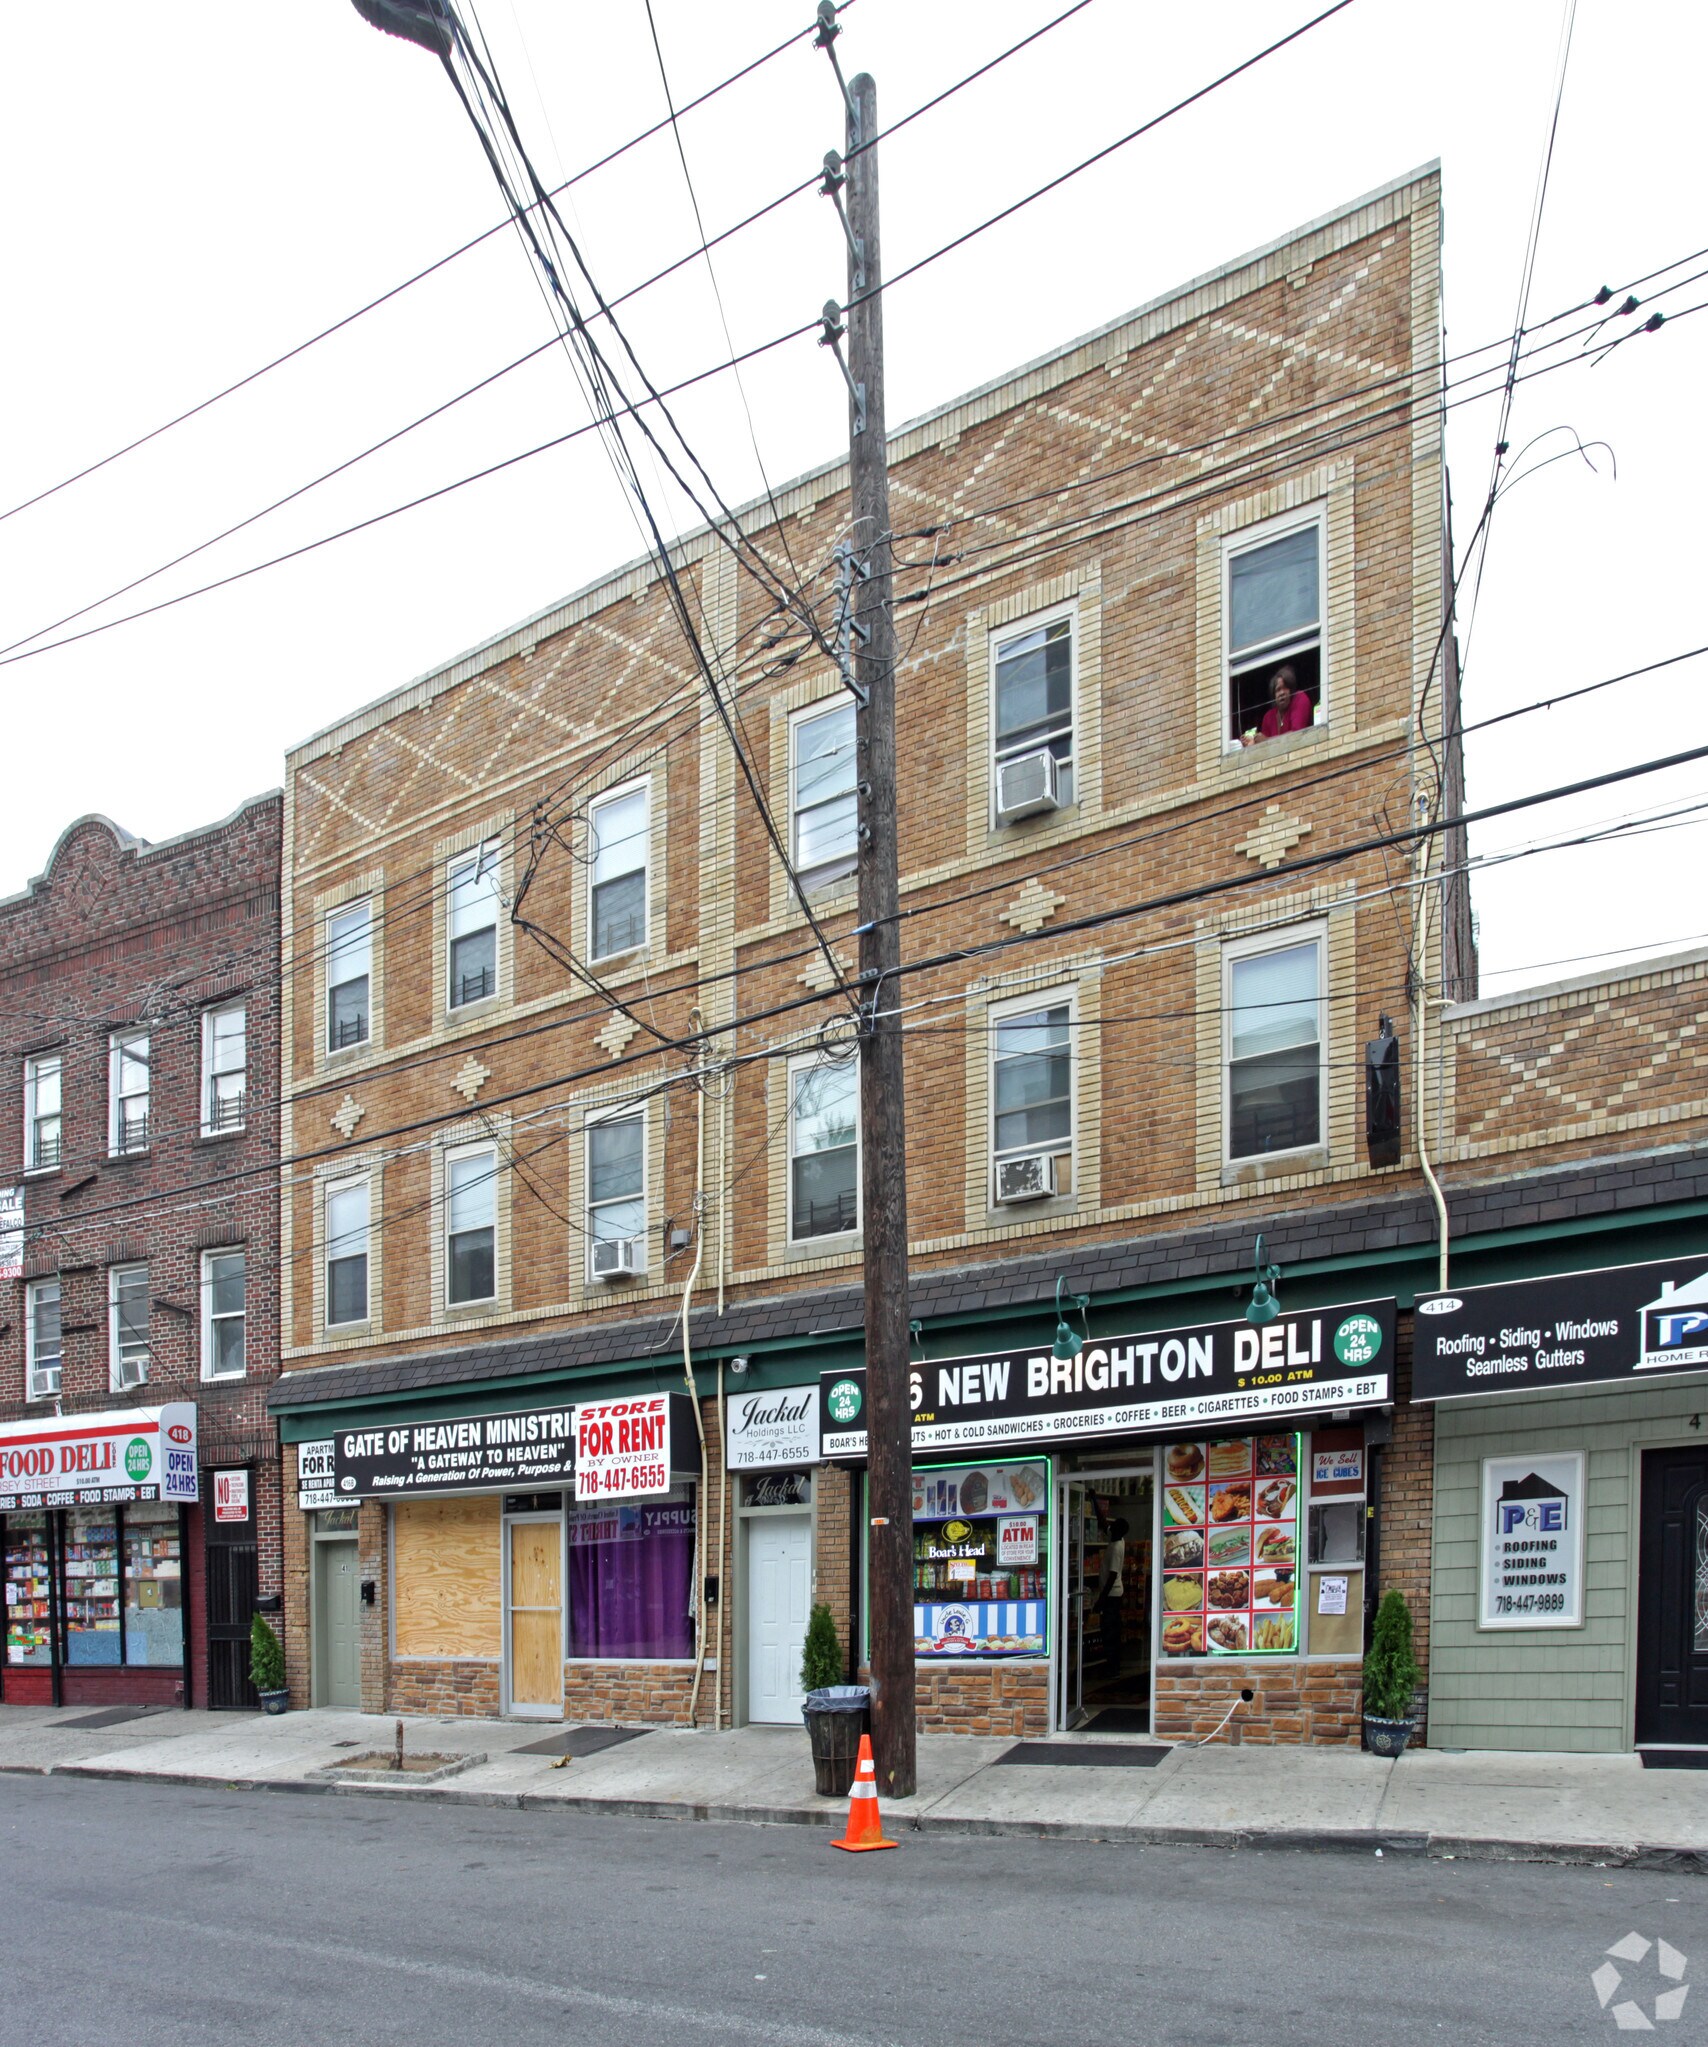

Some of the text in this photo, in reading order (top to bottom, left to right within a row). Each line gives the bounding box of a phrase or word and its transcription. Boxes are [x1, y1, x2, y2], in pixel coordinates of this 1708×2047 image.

[1426, 1300, 1456, 1312] 414
[1338, 1319, 1378, 1337] OPEN
[1350, 1334, 1366, 1348] 24
[1436, 1319, 1618, 1356] Roofing Siding Windows
[1343, 1346, 1372, 1362] HRS
[1646, 1352, 1694, 1364] HOME
[938, 1361, 1010, 1407] NEW
[1027, 1334, 1214, 1398] BRIGHTON
[1234, 1319, 1322, 1373] DELI
[1466, 1350, 1585, 1377] Seamless Gutters
[1238, 1369, 1314, 1388] $ 10.00 ATM
[831, 1384, 858, 1398] OPEN
[580, 1399, 665, 1421] STORE
[839, 1396, 851, 1408] 24
[732, 1393, 812, 1434] Jackal
[830, 1437, 857, 1448] BOAR'S
[934, 1429, 952, 1440] HOT
[954, 1428, 960, 1438] &
[962, 1425, 985, 1438] COLD
[986, 1420, 1044, 1436] SANDWICHES
[1053, 1414, 1105, 1430] GROCERIES
[1115, 1408, 1150, 1423] COFFEE
[1162, 1404, 1186, 1418] BEER
[1198, 1396, 1260, 1414] CIGARETTES
[1271, 1390, 1298, 1405] FOOD
[1302, 1386, 1344, 1402] STAMPS
[1356, 1382, 1377, 1395] EBT
[834, 1406, 856, 1419] HRS
[914, 1413, 935, 1422] ATM
[172, 1428, 188, 1440] 418
[580, 1414, 666, 1458] FOR RENT
[746, 1424, 806, 1438] Holdings LLC
[344, 1432, 384, 1458] GATE
[388, 1430, 409, 1454] OF
[413, 1423, 480, 1452] HEAVEN
[60, 1442, 112, 1474] DELI
[128, 1445, 148, 1458] OPEN
[428, 1450, 482, 1469] GATEWAY
[487, 1450, 502, 1463] TO
[737, 1446, 810, 1464] 718-447-6555
[1319, 1453, 1358, 1466] We Sell
[128, 1458, 150, 1472] 24 HRS
[168, 1452, 192, 1472] OPEN
[302, 1456, 324, 1475] FOR
[588, 1453, 659, 1468] BY OWNER
[372, 1460, 572, 1487] Raising A Generation Of Power, Purpose &
[579, 1464, 665, 1494] 718-447-6555
[1316, 1466, 1358, 1479] ICE CUBES
[24, 1476, 60, 1490] STREET
[166, 1472, 196, 1493] 24 HRS
[218, 1476, 230, 1504] NO
[22, 1494, 42, 1508] SODA
[46, 1492, 74, 1506] COFFEE
[80, 1490, 100, 1503] FOOD
[103, 1488, 136, 1502] STAMPS
[140, 1486, 156, 1500] EBT
[1002, 1527, 1034, 1542] ATM
[929, 1542, 985, 1558] Boar's Head
[1503, 1540, 1557, 1554] ROOFING
[1503, 1557, 1547, 1570] SIDING
[1503, 1573, 1566, 1586] WINDOWS
[1496, 1594, 1564, 1614] 718-447-9889
[940, 1610, 952, 1624] Uncle
[953, 1608, 966, 1618] Louie
